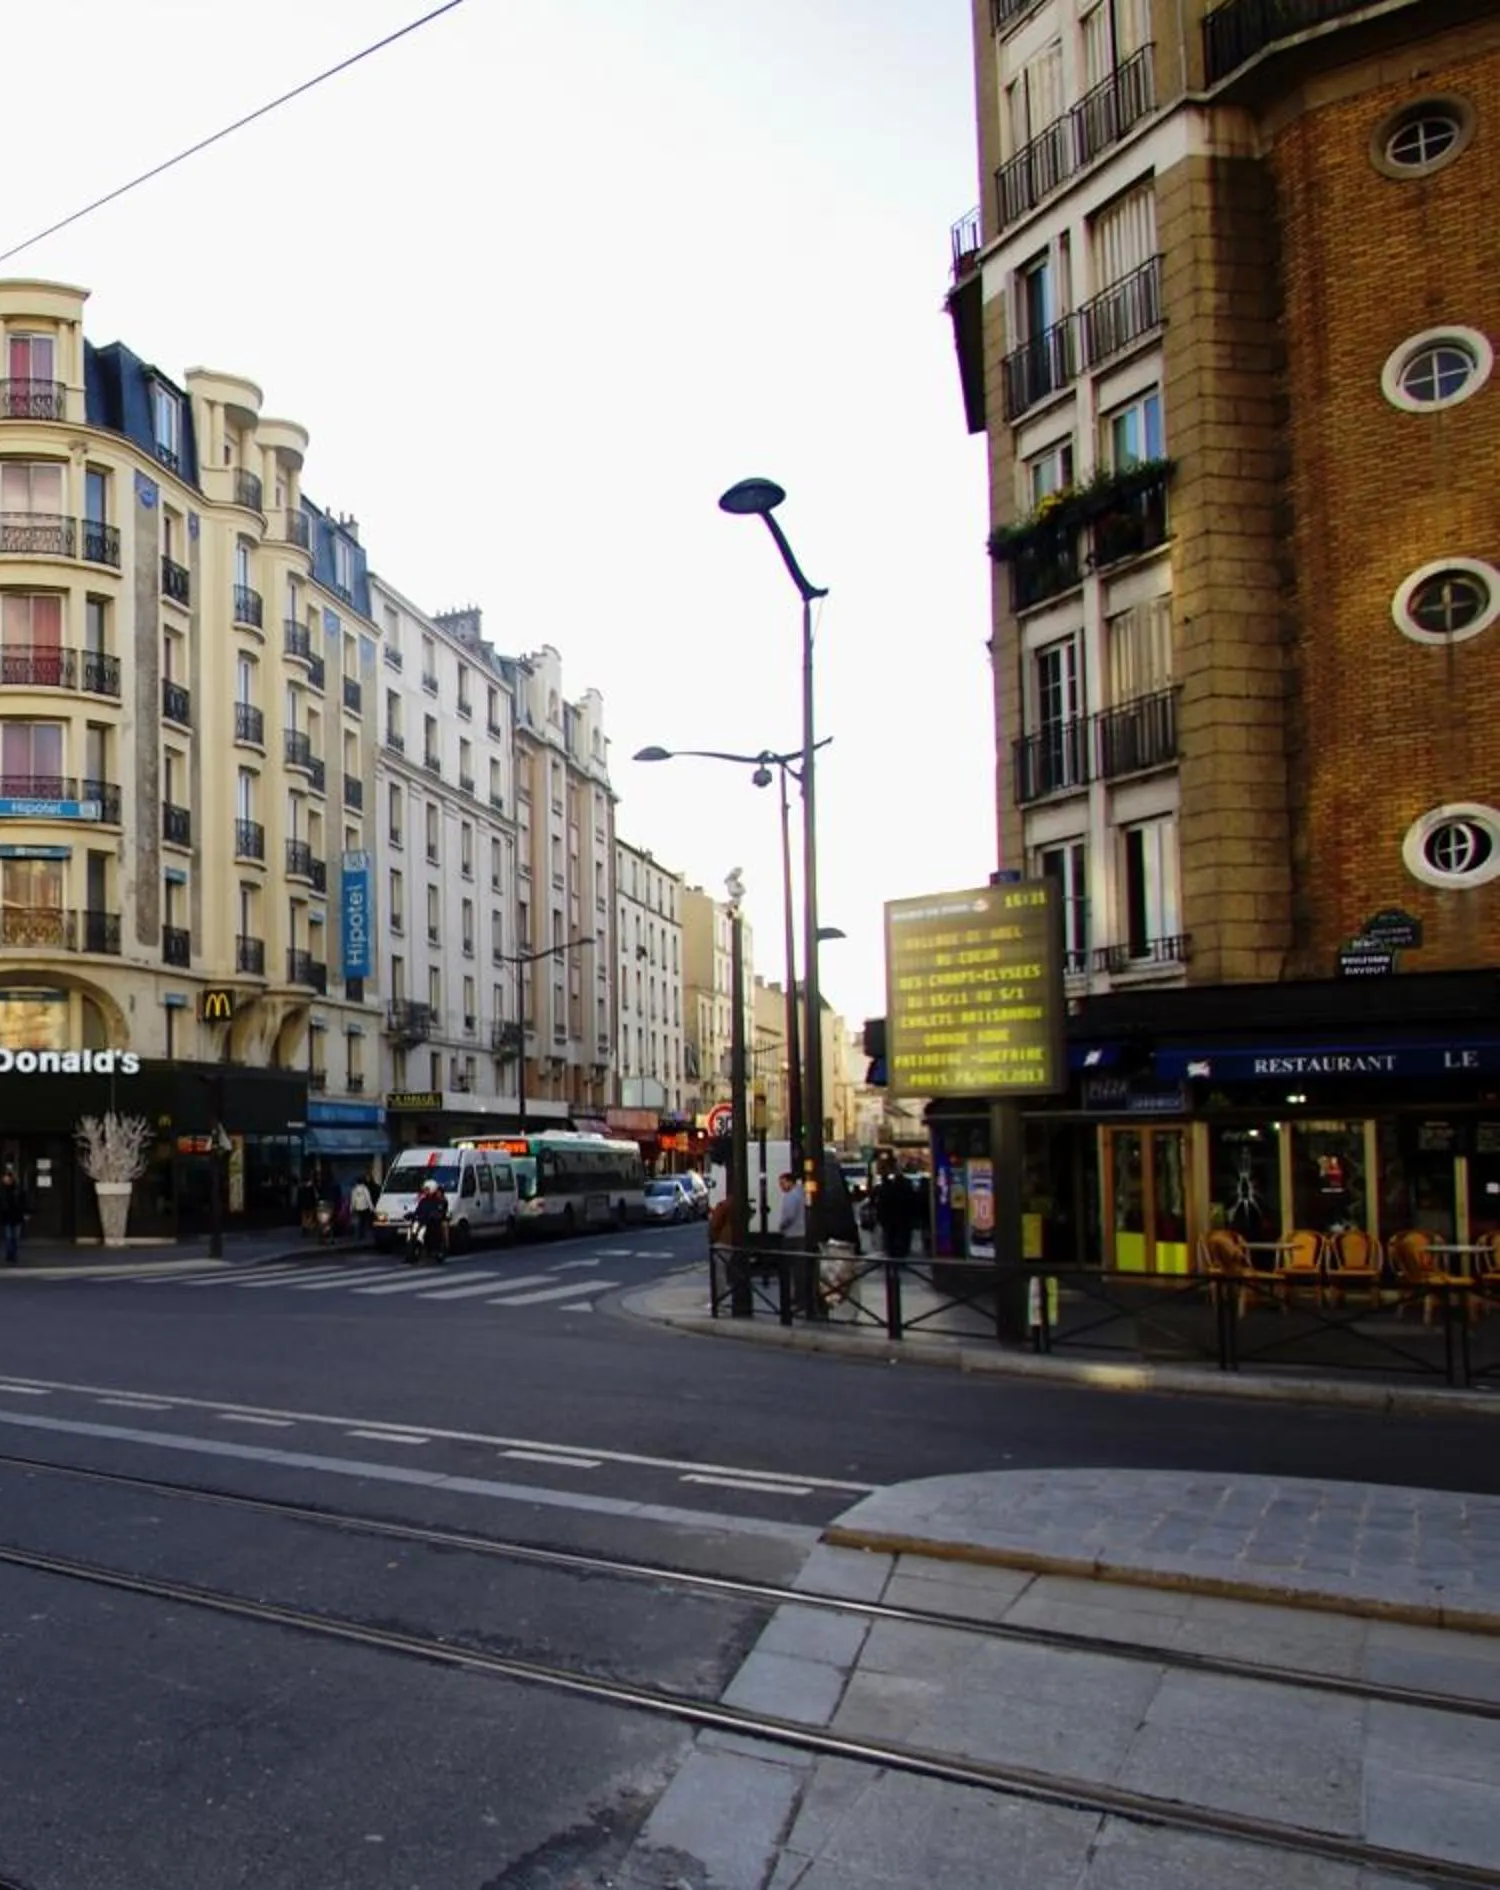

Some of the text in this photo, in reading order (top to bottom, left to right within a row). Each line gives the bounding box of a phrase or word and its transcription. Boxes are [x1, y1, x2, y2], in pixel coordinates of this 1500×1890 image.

[11, 801, 62, 815] Hipotel
[346, 884, 366, 966] Hipotel
[930, 964, 1041, 988] CHAMPS-ELYSEES
[1254, 1050, 1480, 1074] RESTAURANT LE
